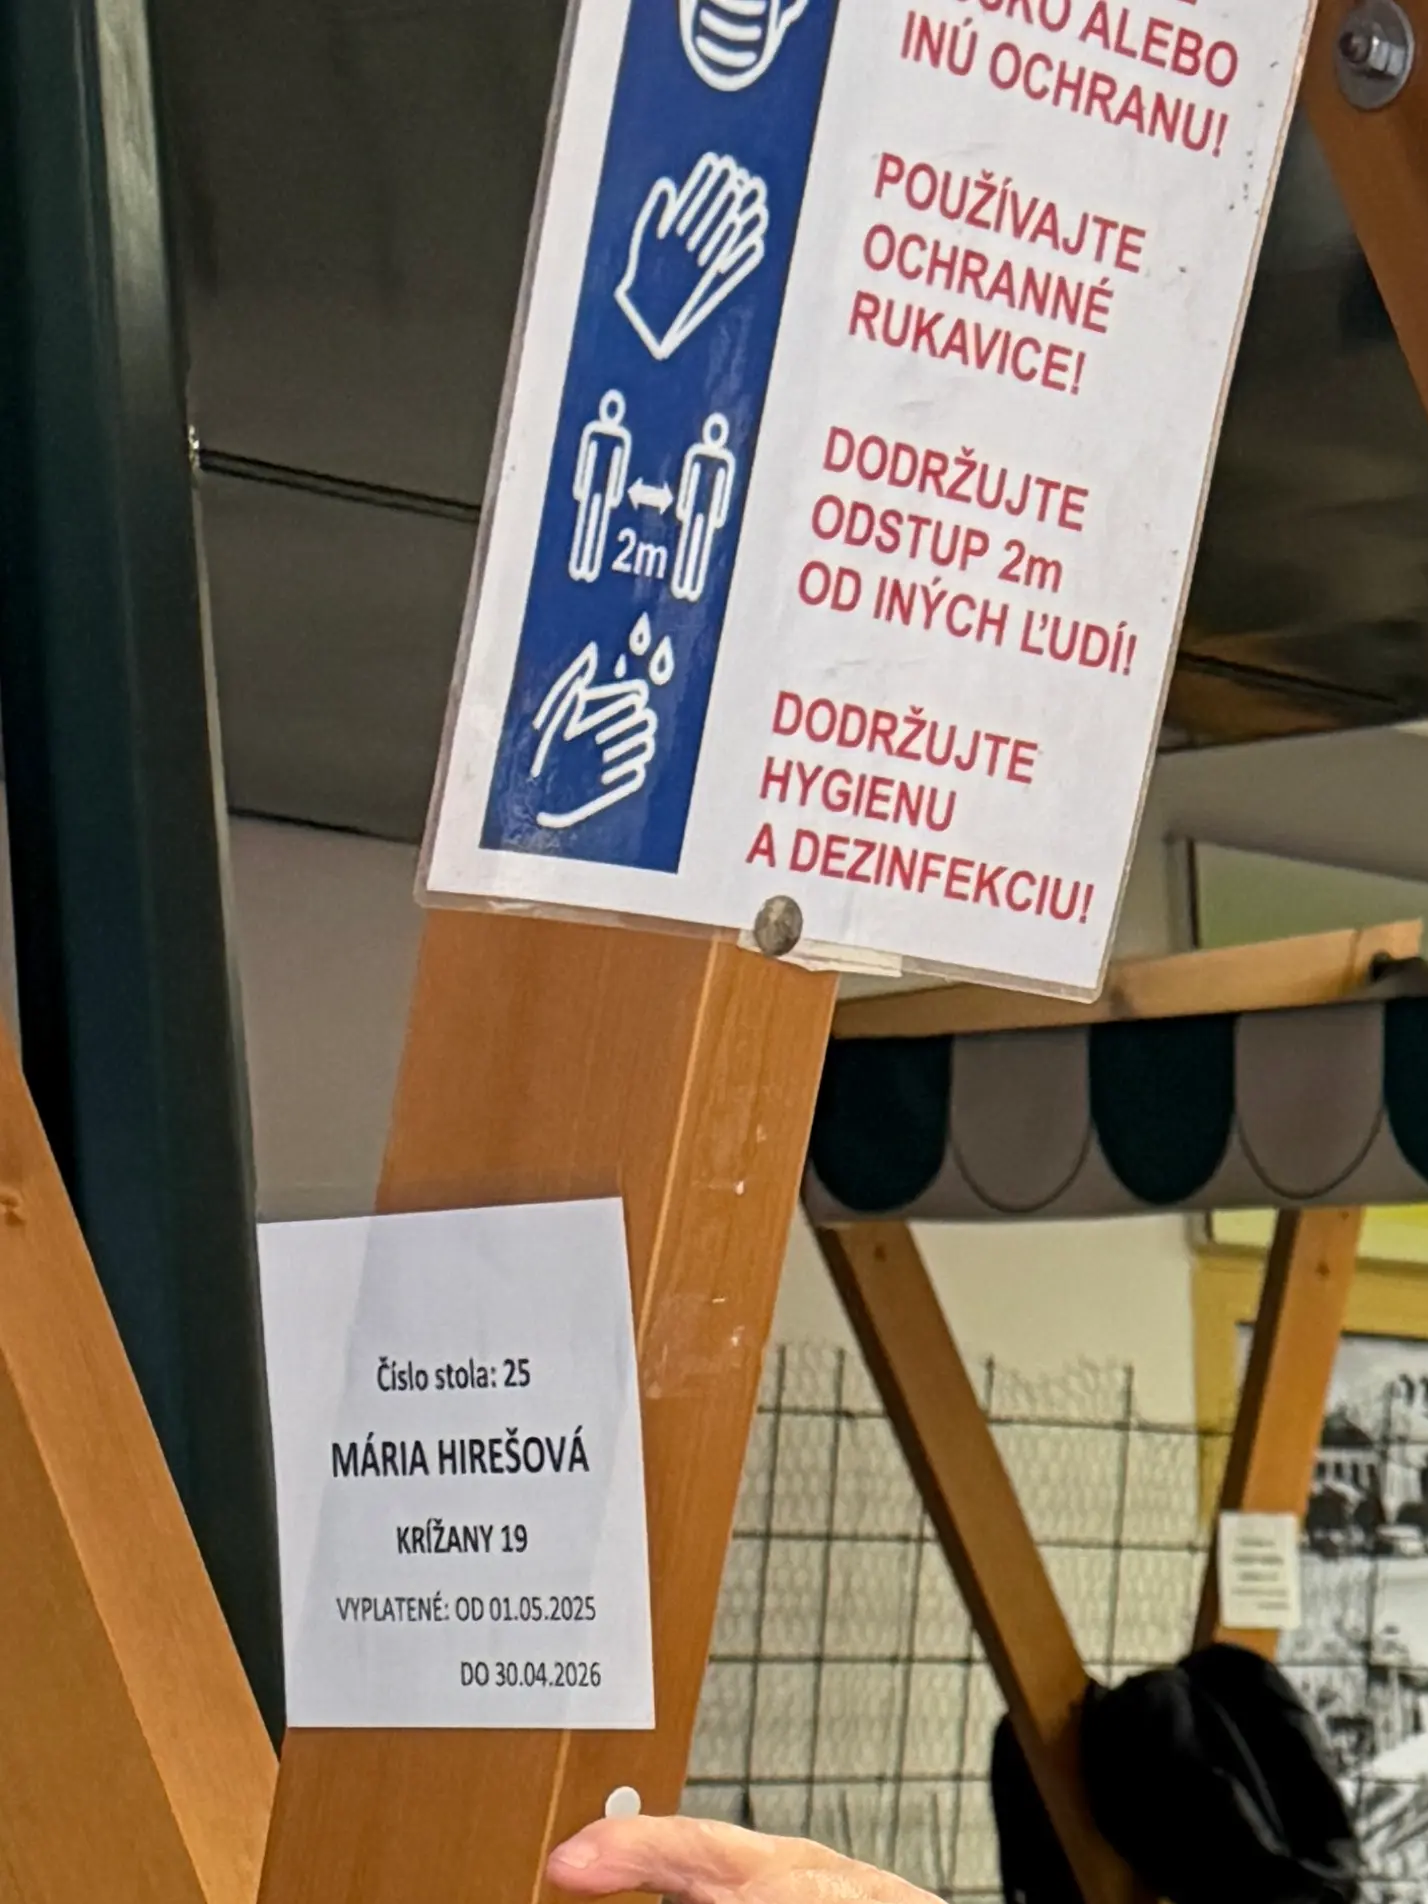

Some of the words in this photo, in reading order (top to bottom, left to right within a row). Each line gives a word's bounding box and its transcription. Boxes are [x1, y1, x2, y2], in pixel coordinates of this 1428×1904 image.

[901, 11, 978, 75] INÚ
[989, 42, 1230, 158] OCHRANU!
[1079, 2, 1238, 87] ALEBO
[874, 152, 1147, 274] POUŽÍVAJTE
[862, 224, 1116, 334] OCHRANNÉ
[848, 290, 1087, 395] RUKAVICE!
[822, 426, 1089, 533] DODRŽUJTE
[612, 528, 668, 579] 2m
[810, 494, 990, 575] ODSTUP
[998, 539, 1063, 593] 2m
[797, 560, 862, 613] OD
[873, 575, 1007, 647] INÝCH
[1019, 614, 1139, 676] ĽUDÍ!
[771, 690, 1039, 785] DODRŽUJTE
[759, 756, 957, 833] HYGIENU
[746, 822, 778, 868] A
[787, 827, 1095, 925] DEZINFEKCIU!
[376, 1355, 429, 1393] Číslo
[434, 1357, 498, 1392] stola:
[503, 1358, 531, 1388] 25
[331, 1431, 430, 1479] MÁRIA
[437, 1425, 590, 1476] HIREŠOVÁ
[396, 1516, 494, 1556] KRÍŽANY
[500, 1523, 528, 1554] 19
[335, 1590, 451, 1623] VYPLATENÉ:
[455, 1597, 486, 1623] OD
[489, 1595, 597, 1622] 01.05.2025
[460, 1661, 490, 1689] DO
[495, 1661, 602, 1689] 30.04.2026
